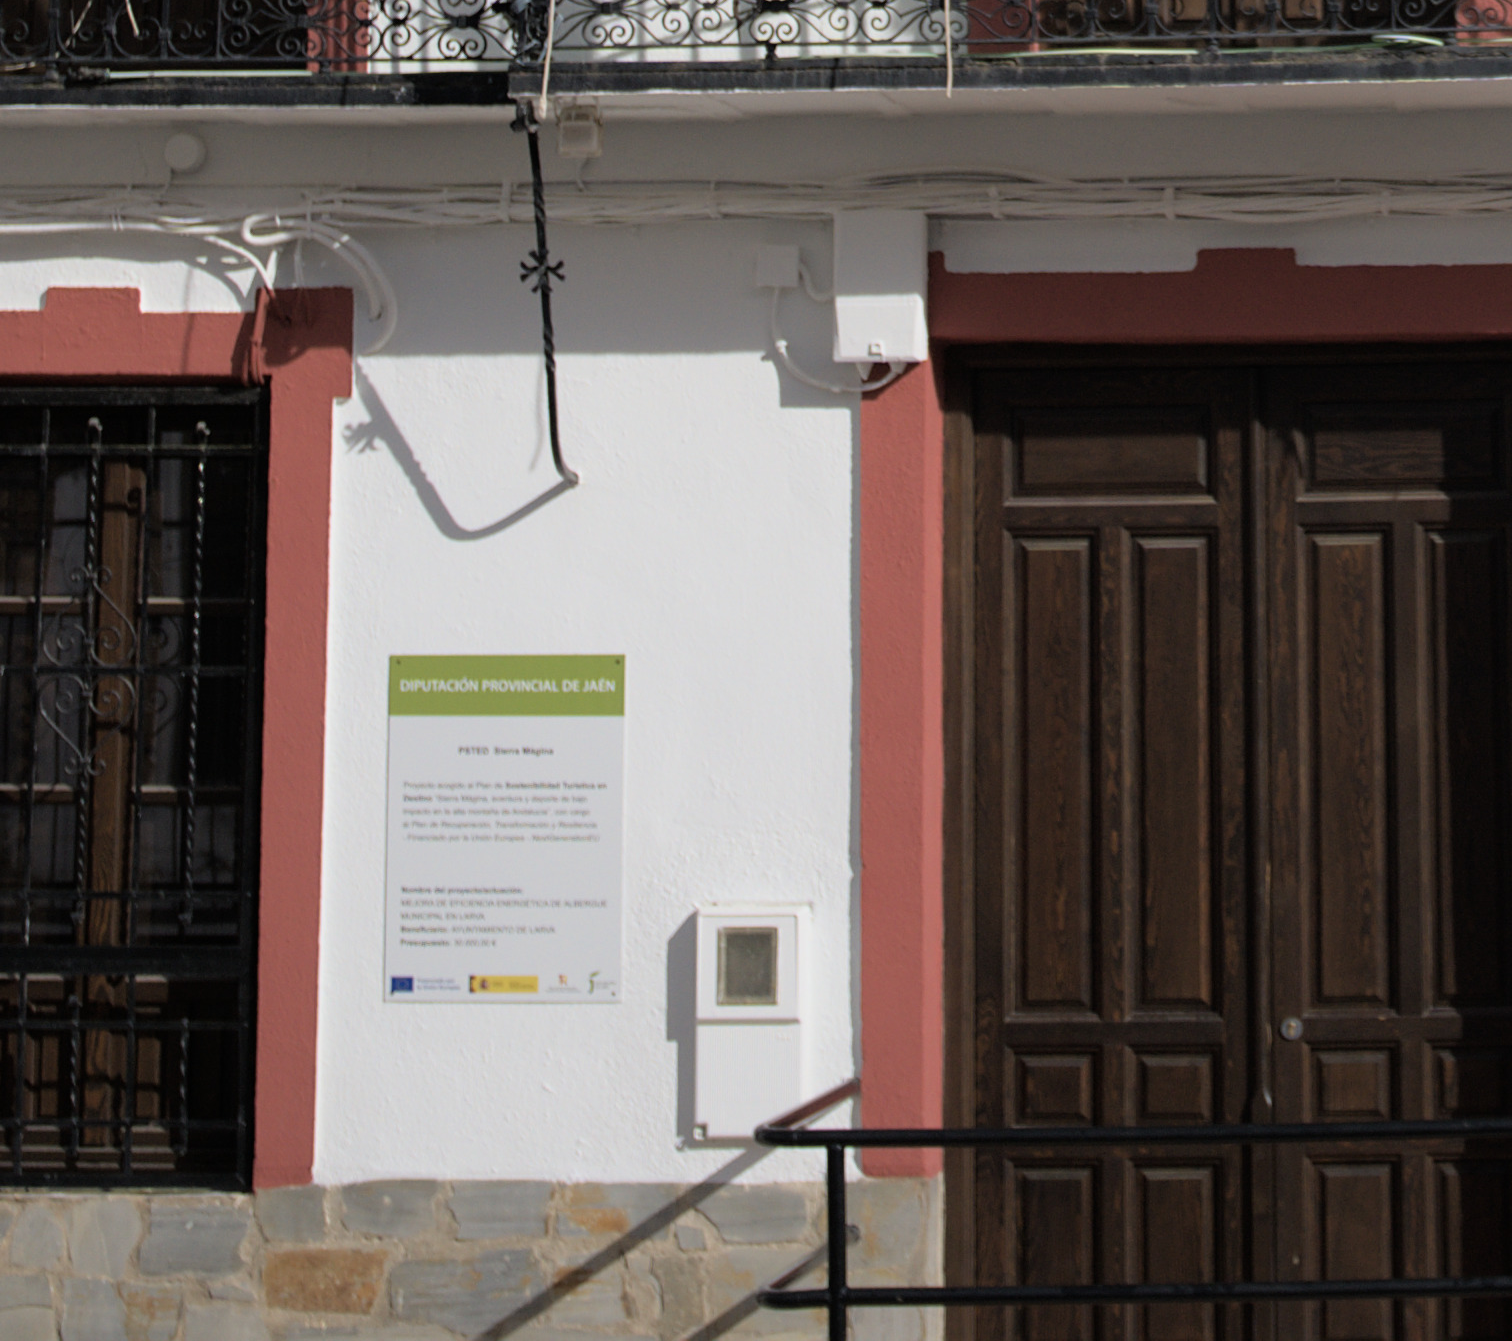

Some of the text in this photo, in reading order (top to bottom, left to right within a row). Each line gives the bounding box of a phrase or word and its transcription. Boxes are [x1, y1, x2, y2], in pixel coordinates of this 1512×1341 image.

[399, 676, 616, 694] DIPUTACIÓN PROVINCIAL DE JAÉN
